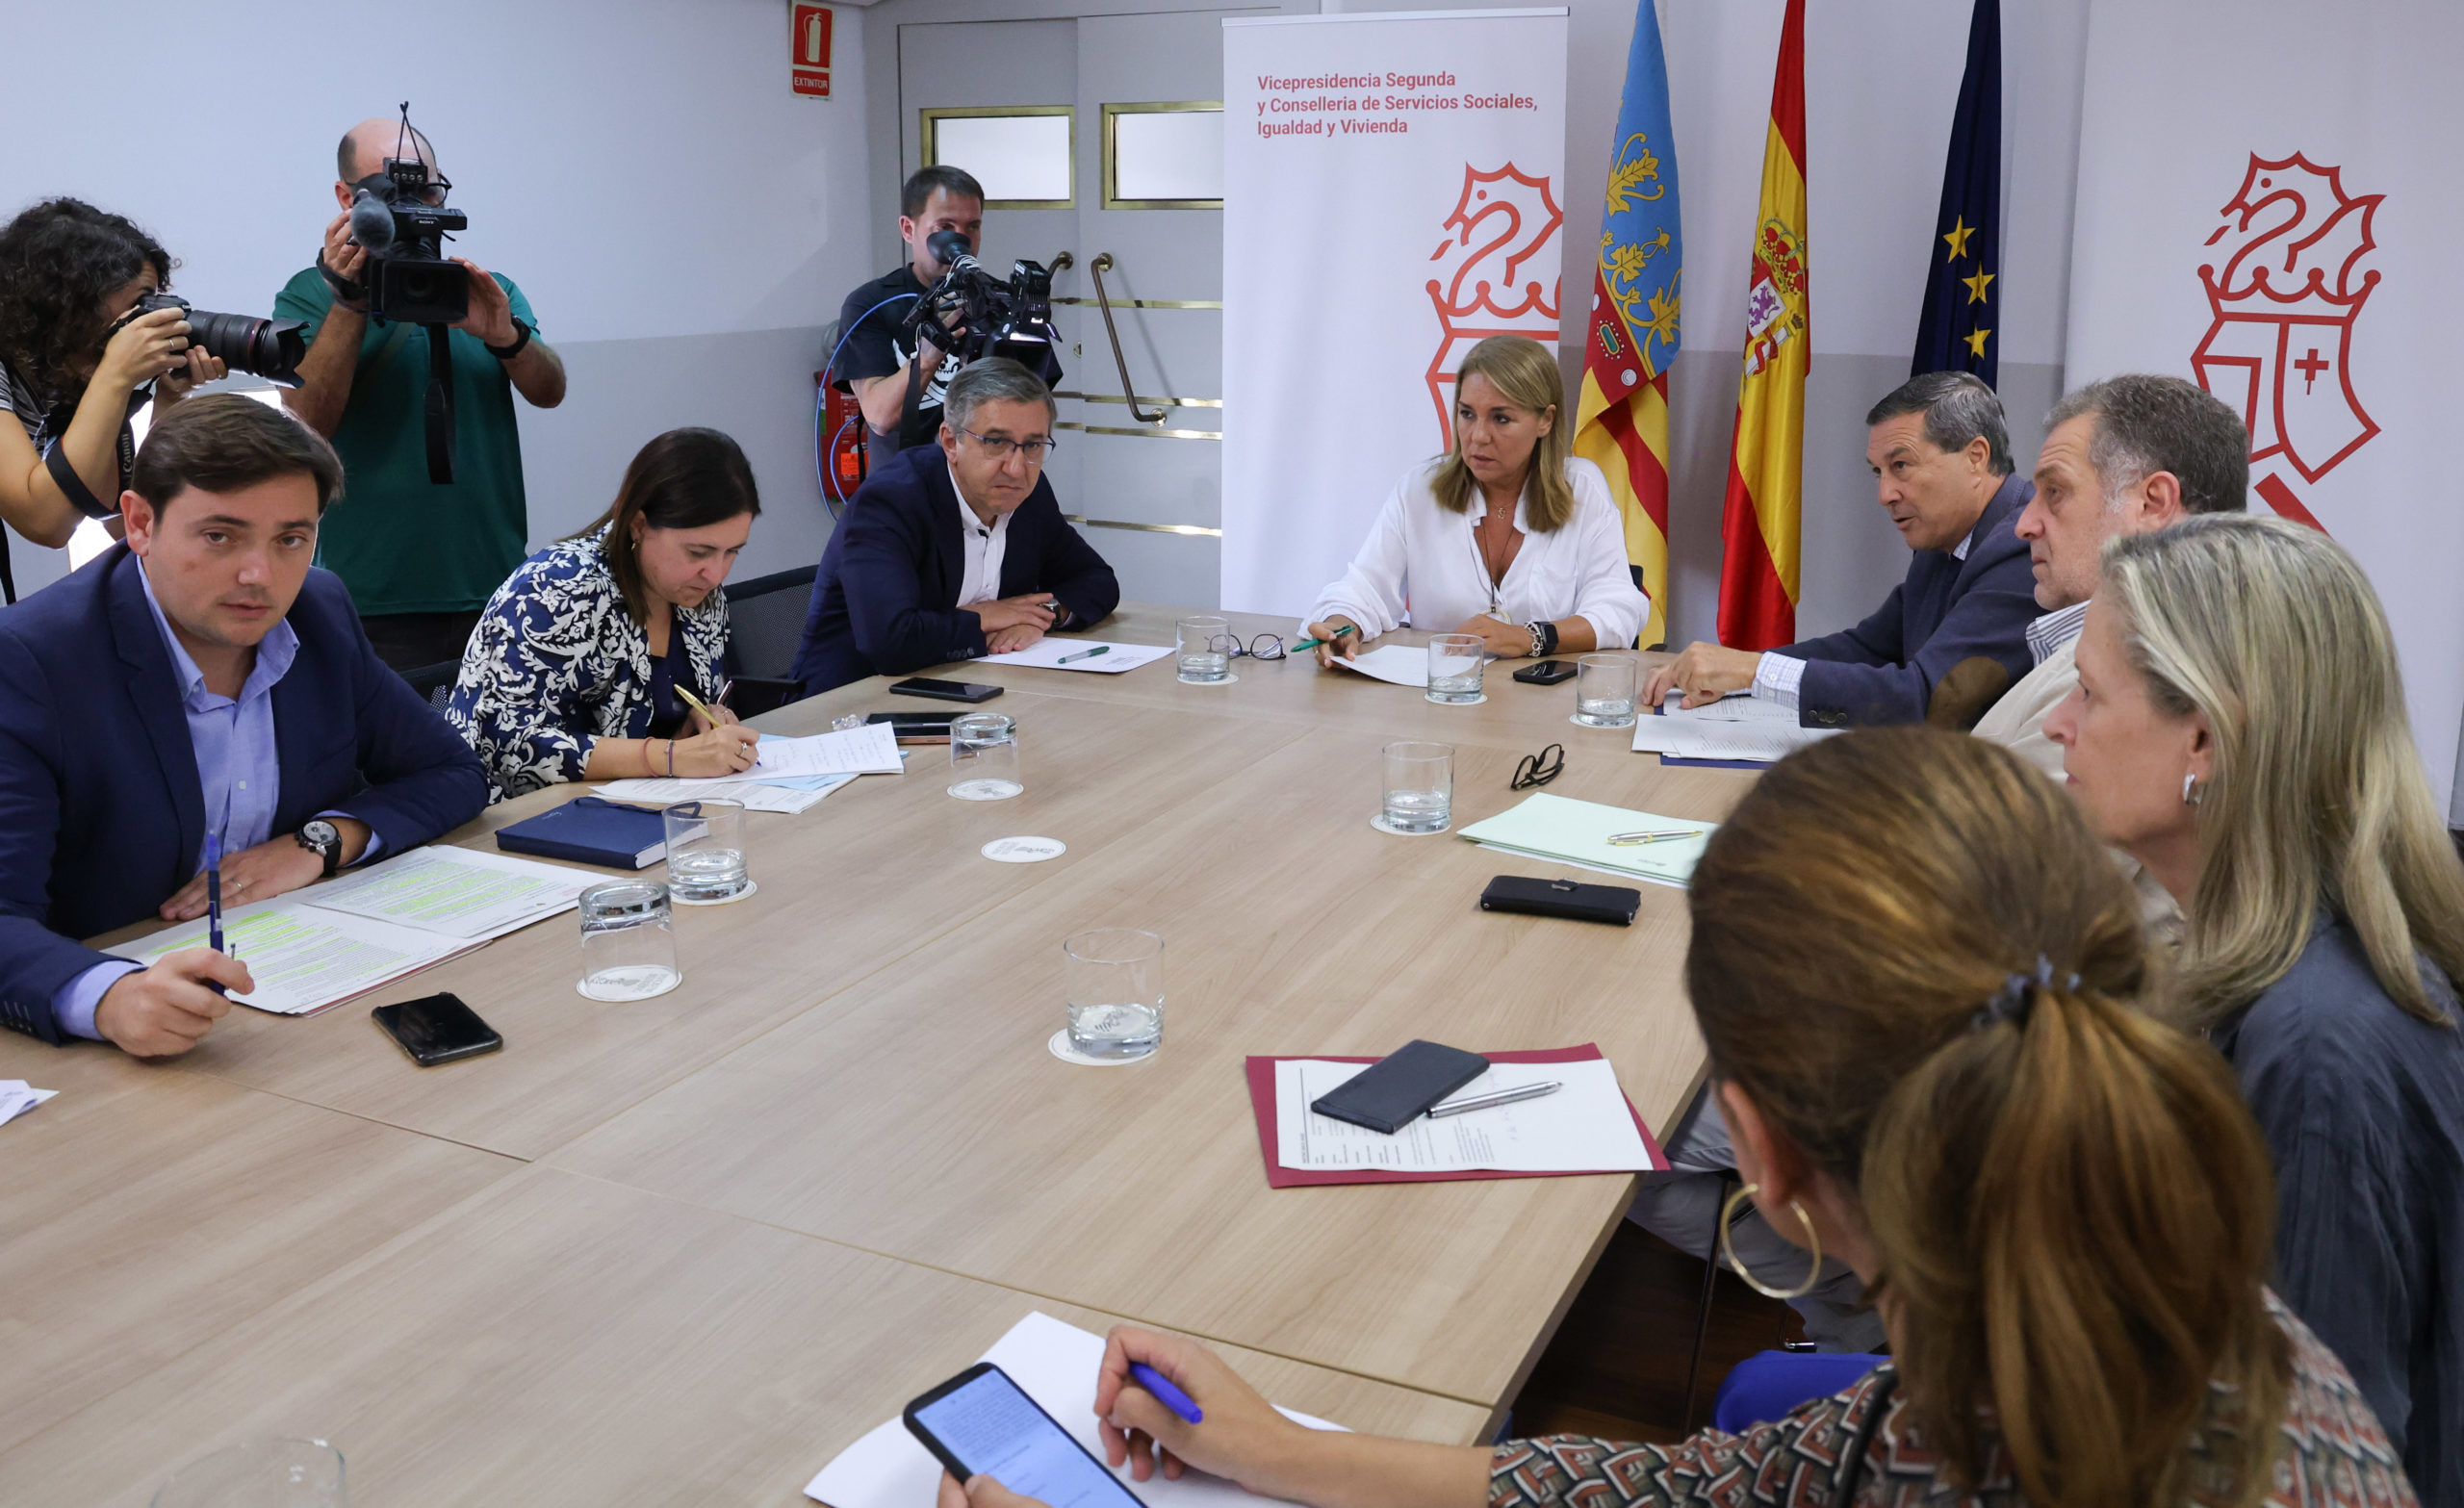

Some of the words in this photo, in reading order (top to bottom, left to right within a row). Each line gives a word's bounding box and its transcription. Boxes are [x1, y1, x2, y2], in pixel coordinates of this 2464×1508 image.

[794, 77, 829, 89] EXTINTOR
[1258, 74, 1380, 92] Vicepresidencia
[1386, 71, 1455, 90] Segunda
[1257, 101, 1267, 116] y
[1271, 97, 1357, 112] Conselleria
[1362, 96, 1380, 110] de
[1386, 95, 1459, 110] Servicios
[1464, 93, 1538, 112] Sociales,
[1258, 120, 1322, 139] Igualdad
[1326, 122, 1337, 138] y
[1341, 117, 1407, 133] Vivienda
[122, 433, 133, 473] Canon
